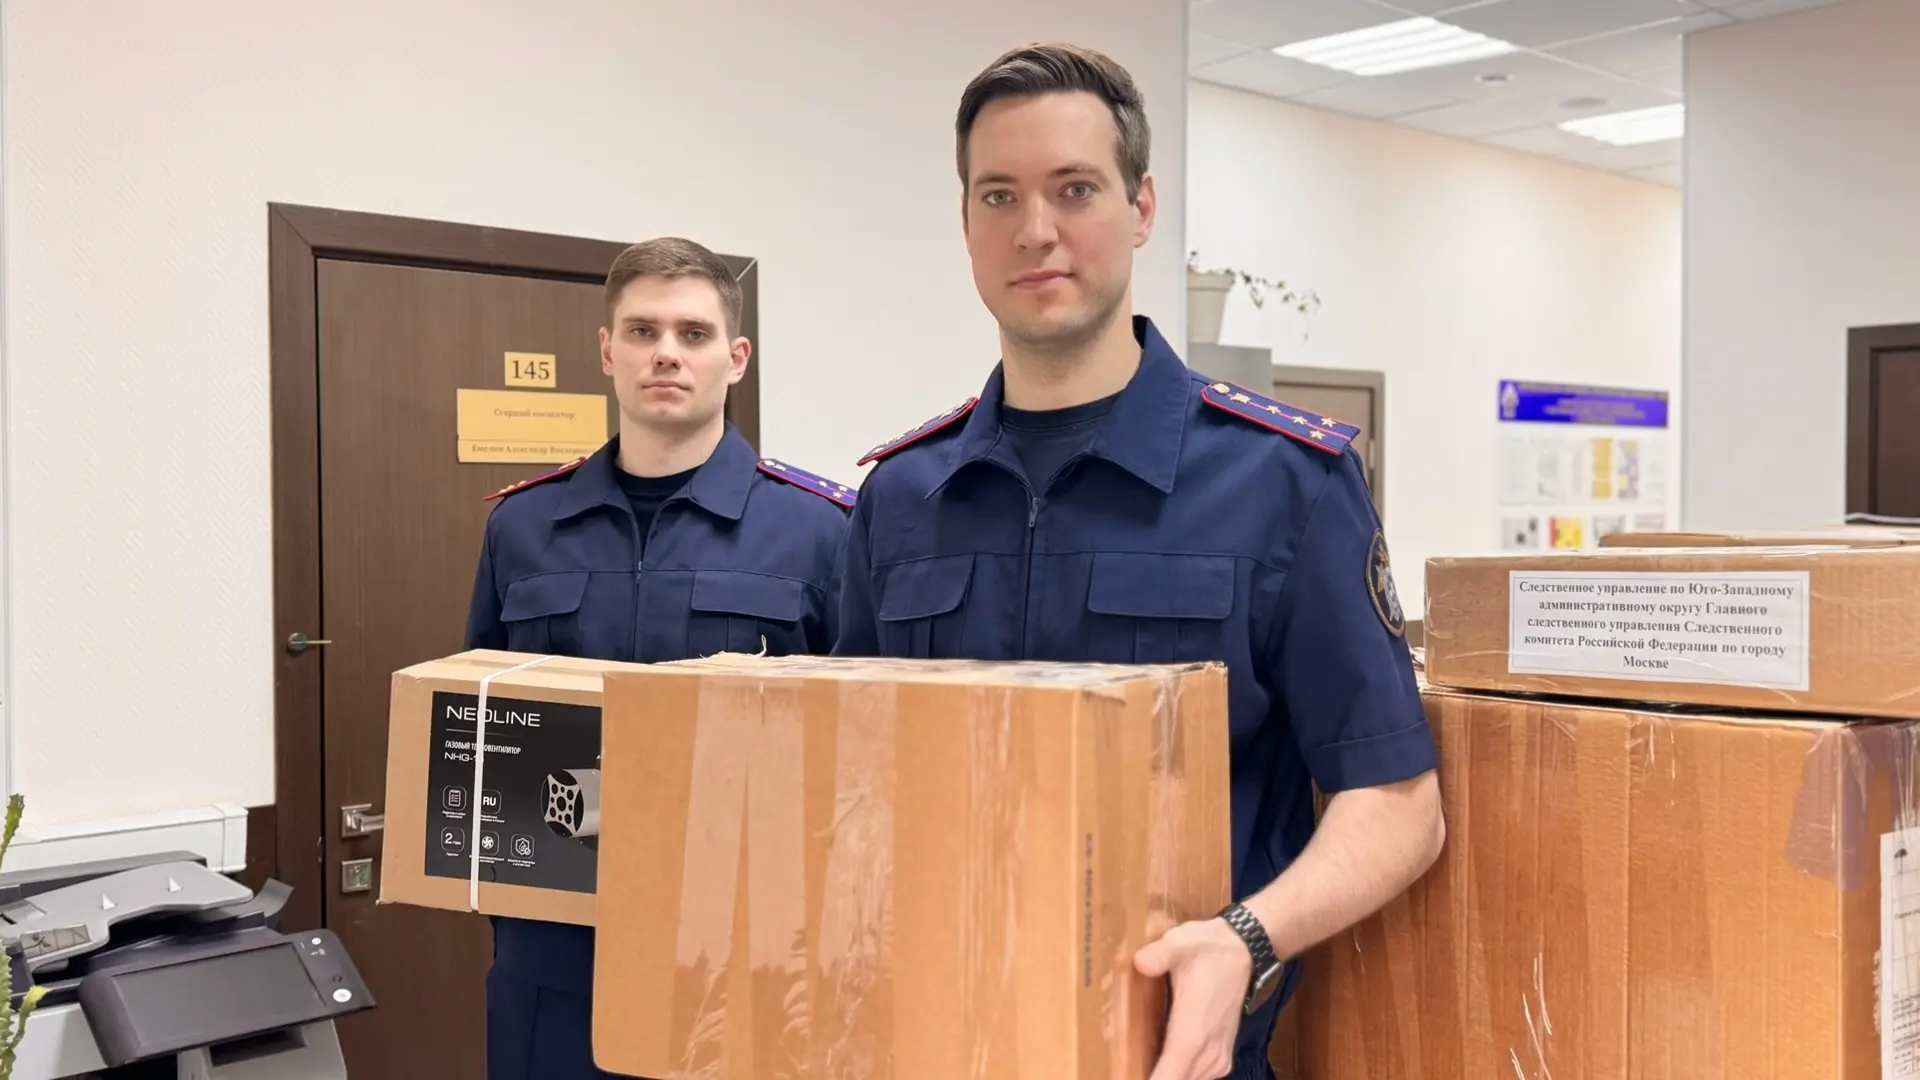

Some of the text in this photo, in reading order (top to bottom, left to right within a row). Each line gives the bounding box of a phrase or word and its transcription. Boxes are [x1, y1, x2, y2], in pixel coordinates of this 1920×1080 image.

[511, 360, 550, 380] 145
[1519, 581, 1794, 599] Следственное управление по Юго-Западному
[1538, 600, 1768, 616] административному округу Главного
[1527, 618, 1783, 636] следственного управления Следственного
[1524, 634, 1787, 659] комитета Российской Федерации по городу
[1623, 655, 1669, 669] Москве
[446, 705, 541, 727] NEOLINE
[445, 740, 522, 755] ГАЗОВЫЙ ТЕОВЕНТИЛЯТОР
[482, 796, 497, 806] RU
[444, 832, 453, 845] 2
